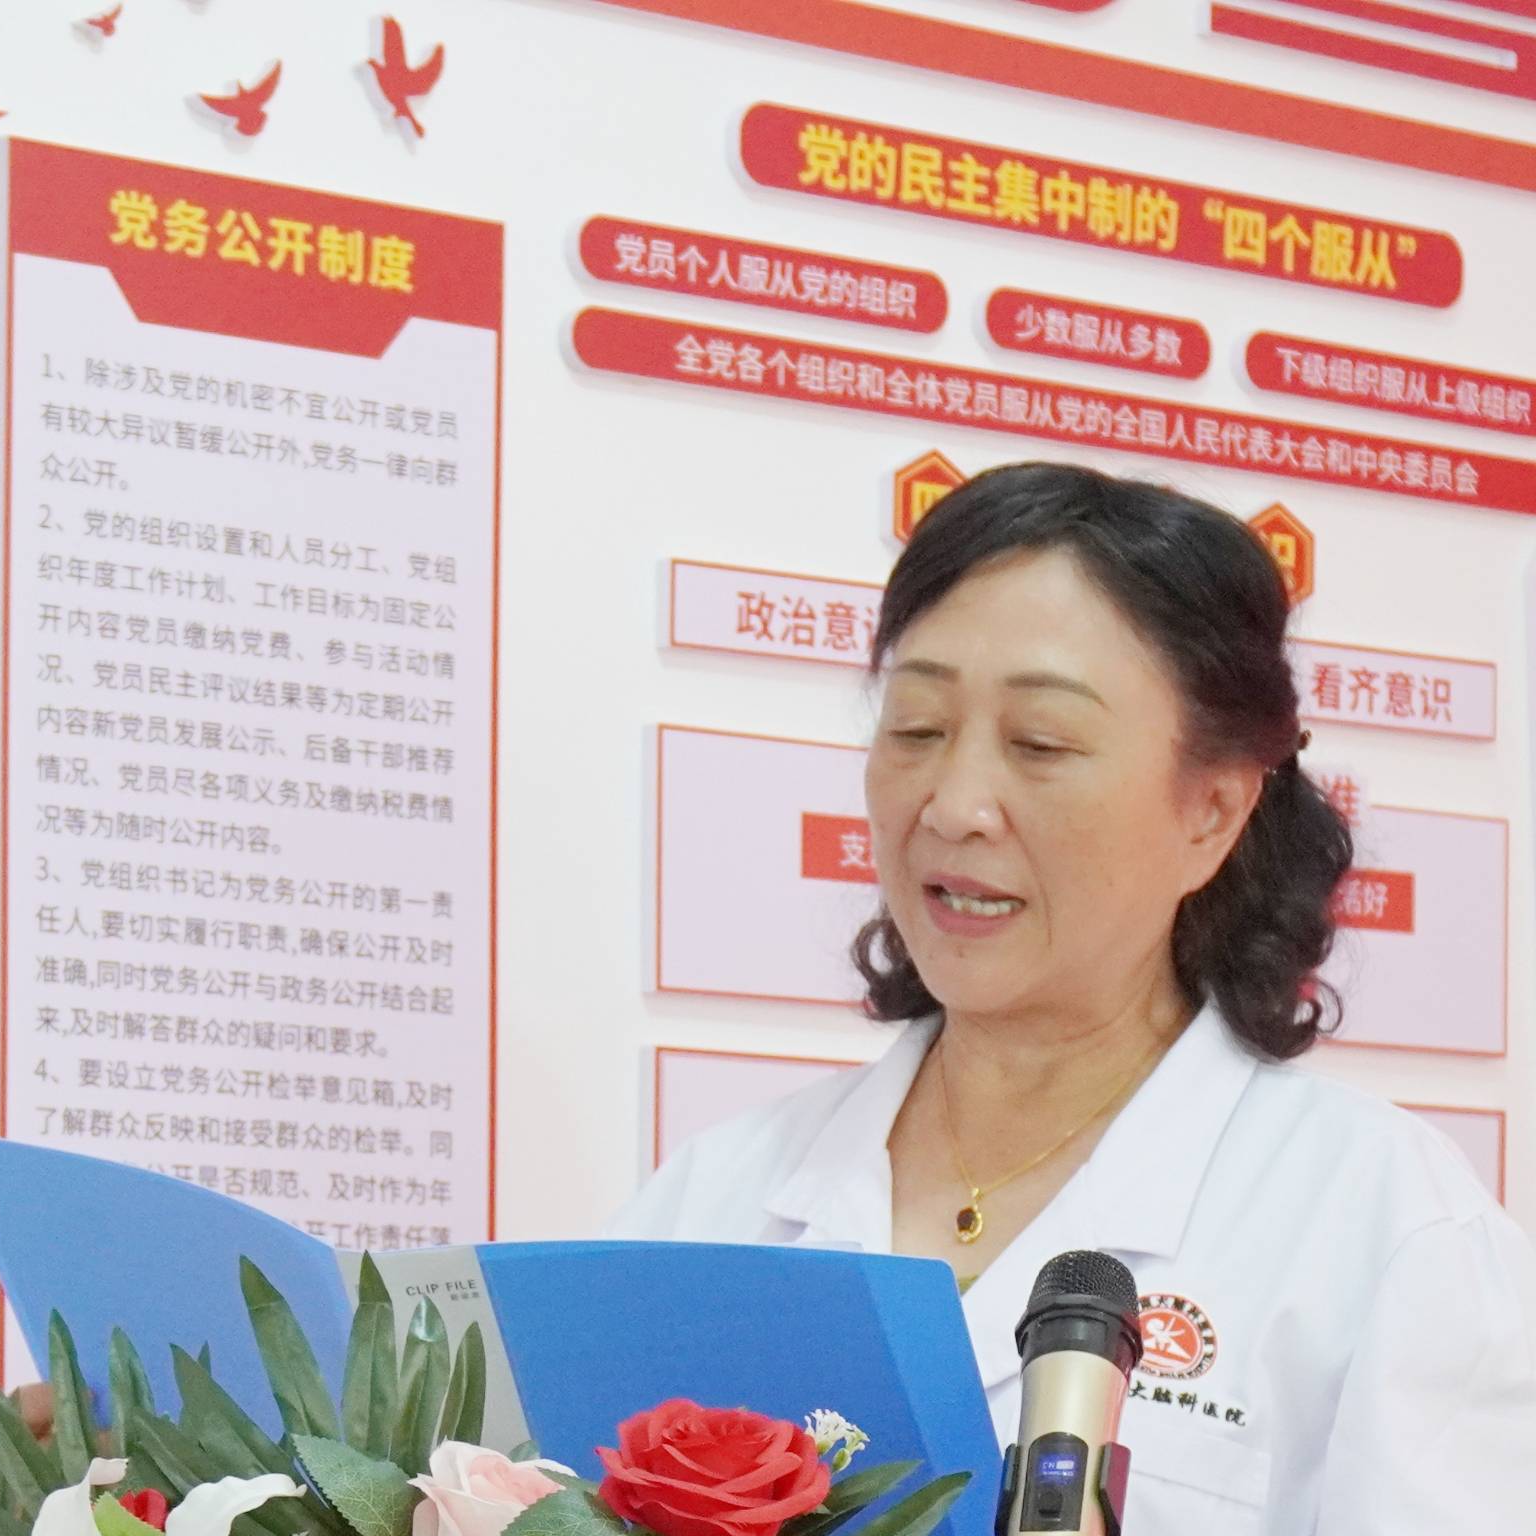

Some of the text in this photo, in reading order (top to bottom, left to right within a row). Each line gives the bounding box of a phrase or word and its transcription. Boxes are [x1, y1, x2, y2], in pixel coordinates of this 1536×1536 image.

[108, 189, 417, 294] 党务公开制度
[798, 124, 1417, 289] 党的民主集中制的“四个服从”
[613, 232, 917, 321] 党员个人服从党的组织
[1015, 303, 1183, 368] 少数服从多数
[1275, 346, 1532, 426] 下级组织服从上级组织
[1312, 661, 1453, 722] 看齐意识
[839, 830, 874, 868] 支
[405, 1283, 439, 1297] CLIP
[446, 1279, 478, 1291] FILE
